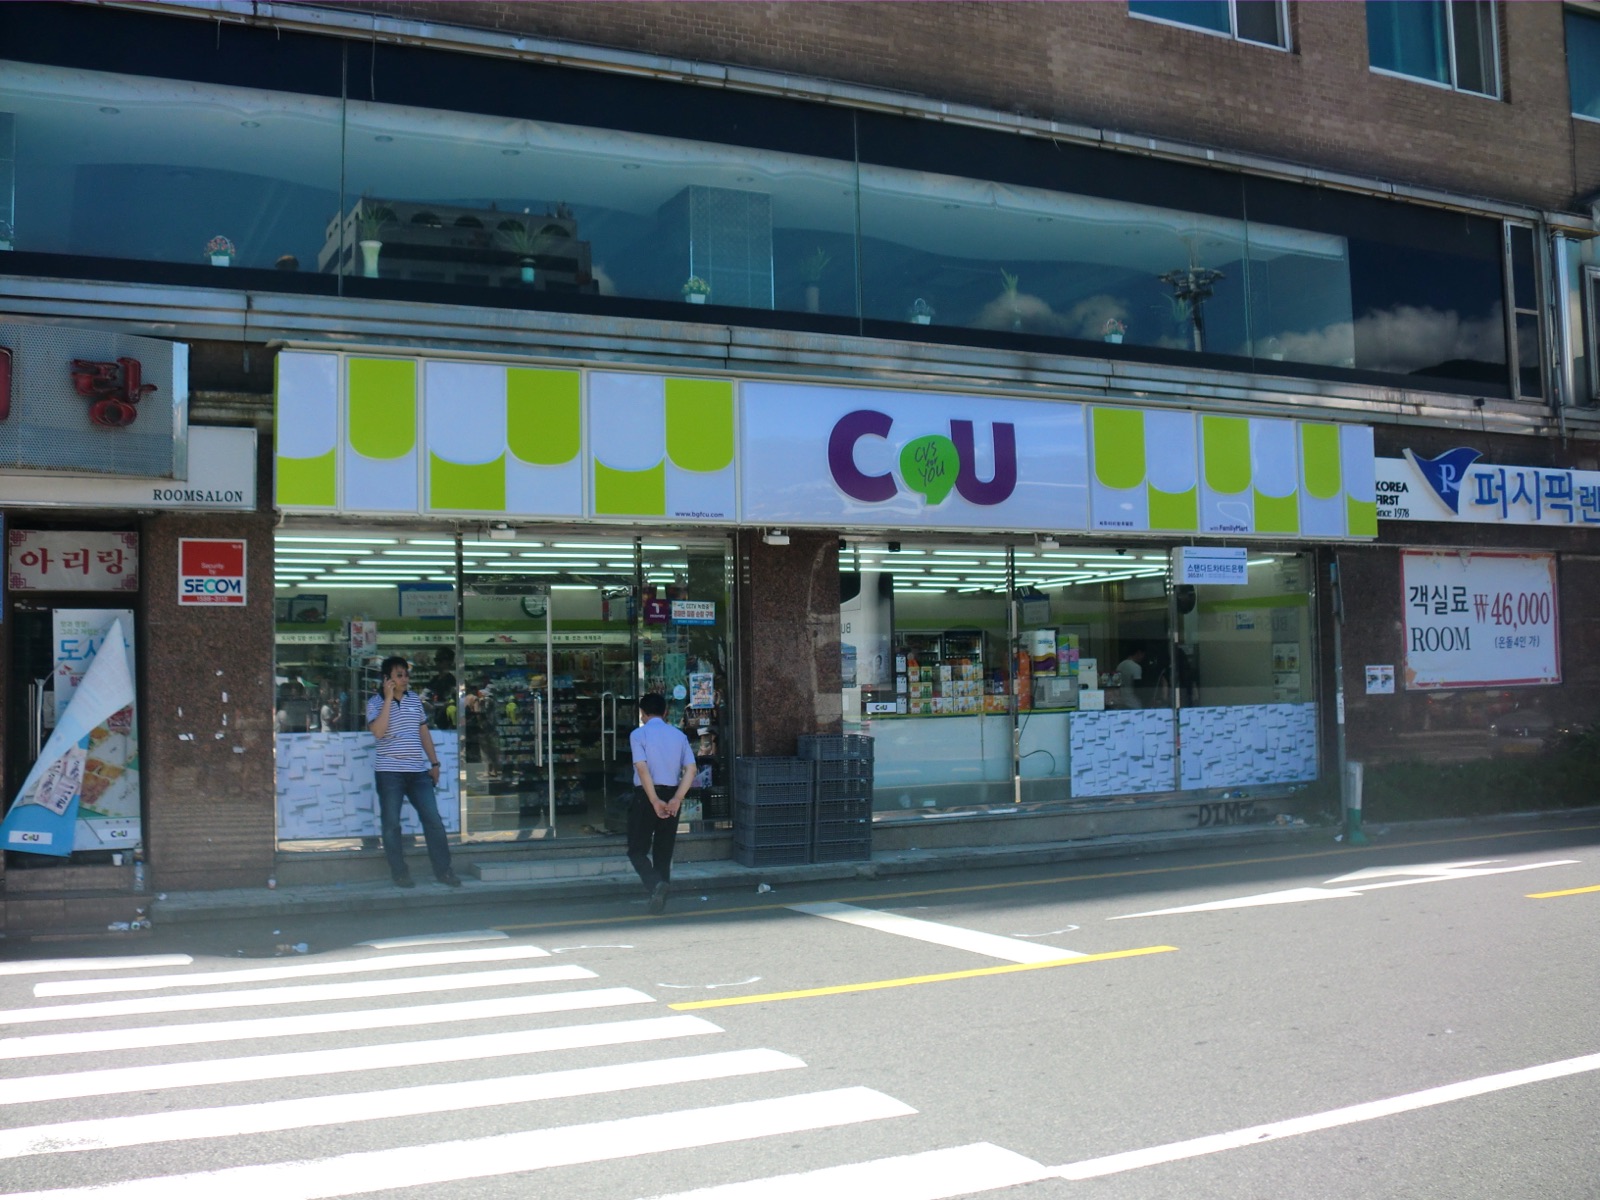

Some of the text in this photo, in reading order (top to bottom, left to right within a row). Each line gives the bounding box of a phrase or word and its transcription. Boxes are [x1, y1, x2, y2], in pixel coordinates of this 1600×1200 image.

[828, 410, 1017, 505] CU
[914, 441, 937, 463] CVS
[918, 460, 945, 487] YOU
[1376, 481, 1409, 493] KOREA
[153, 489, 243, 502] ROOMSALON
[1376, 494, 1400, 506] FIRST
[1394, 508, 1410, 519] 1978
[1219, 524, 1248, 533] FamilyMart
[20, 548, 129, 575] 아리랑
[201, 562, 225, 571] Security
[1187, 564, 1244, 573] 스탠다드차타드은행
[184, 578, 241, 594] SECOM
[1409, 585, 1470, 615] 객실료
[1411, 626, 1471, 652] ROOM
